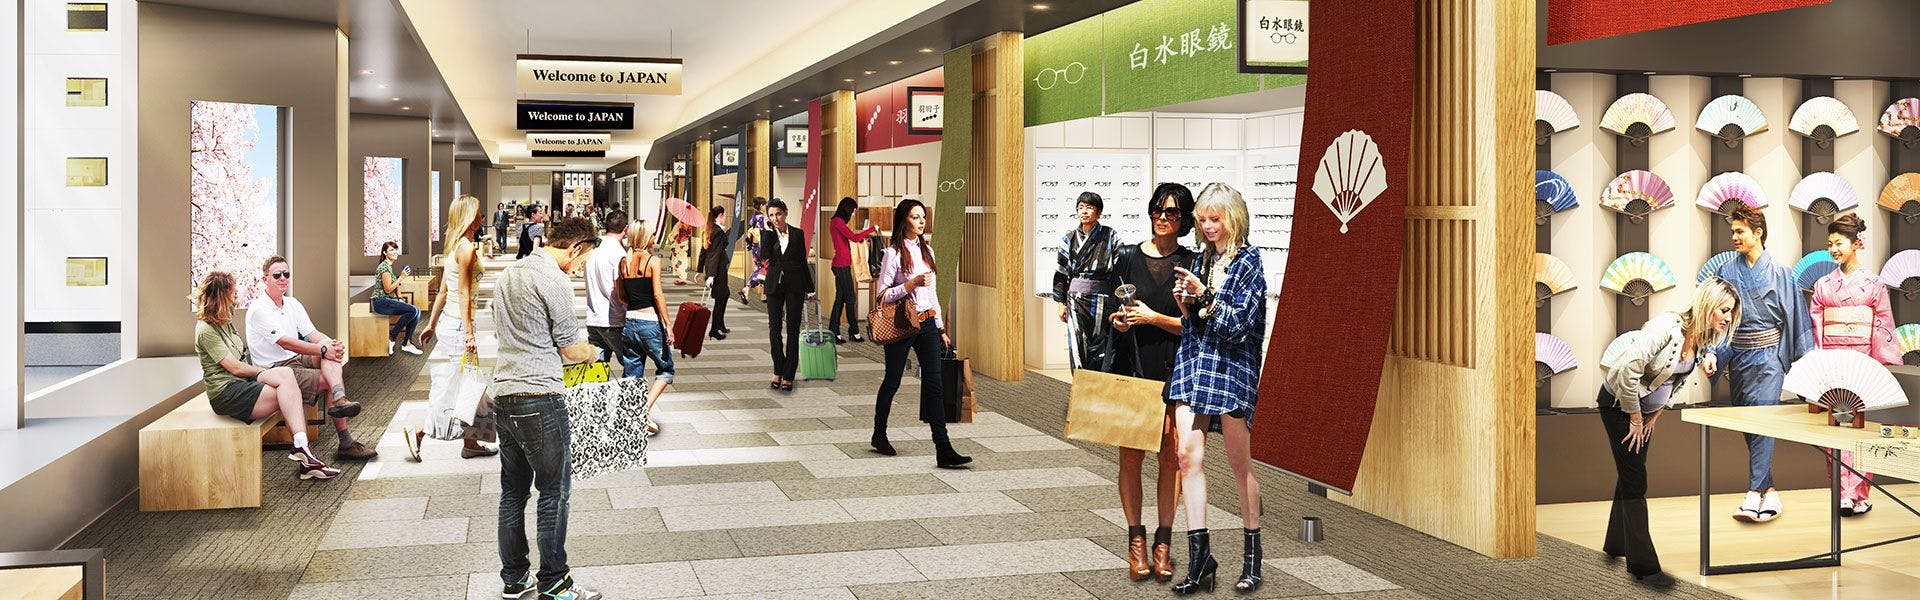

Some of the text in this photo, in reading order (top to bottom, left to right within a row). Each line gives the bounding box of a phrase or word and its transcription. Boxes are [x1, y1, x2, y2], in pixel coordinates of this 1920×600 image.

[1259, 15, 1305, 33] 白水眼鏡
[1128, 21, 1233, 71] 白水眼鏡
[533, 69, 668, 84] Welcome to JAPAN
[528, 111, 624, 122] Welcome to JAPAN
[534, 137, 567, 145] Welcome
[576, 138, 603, 146] JAPAN
